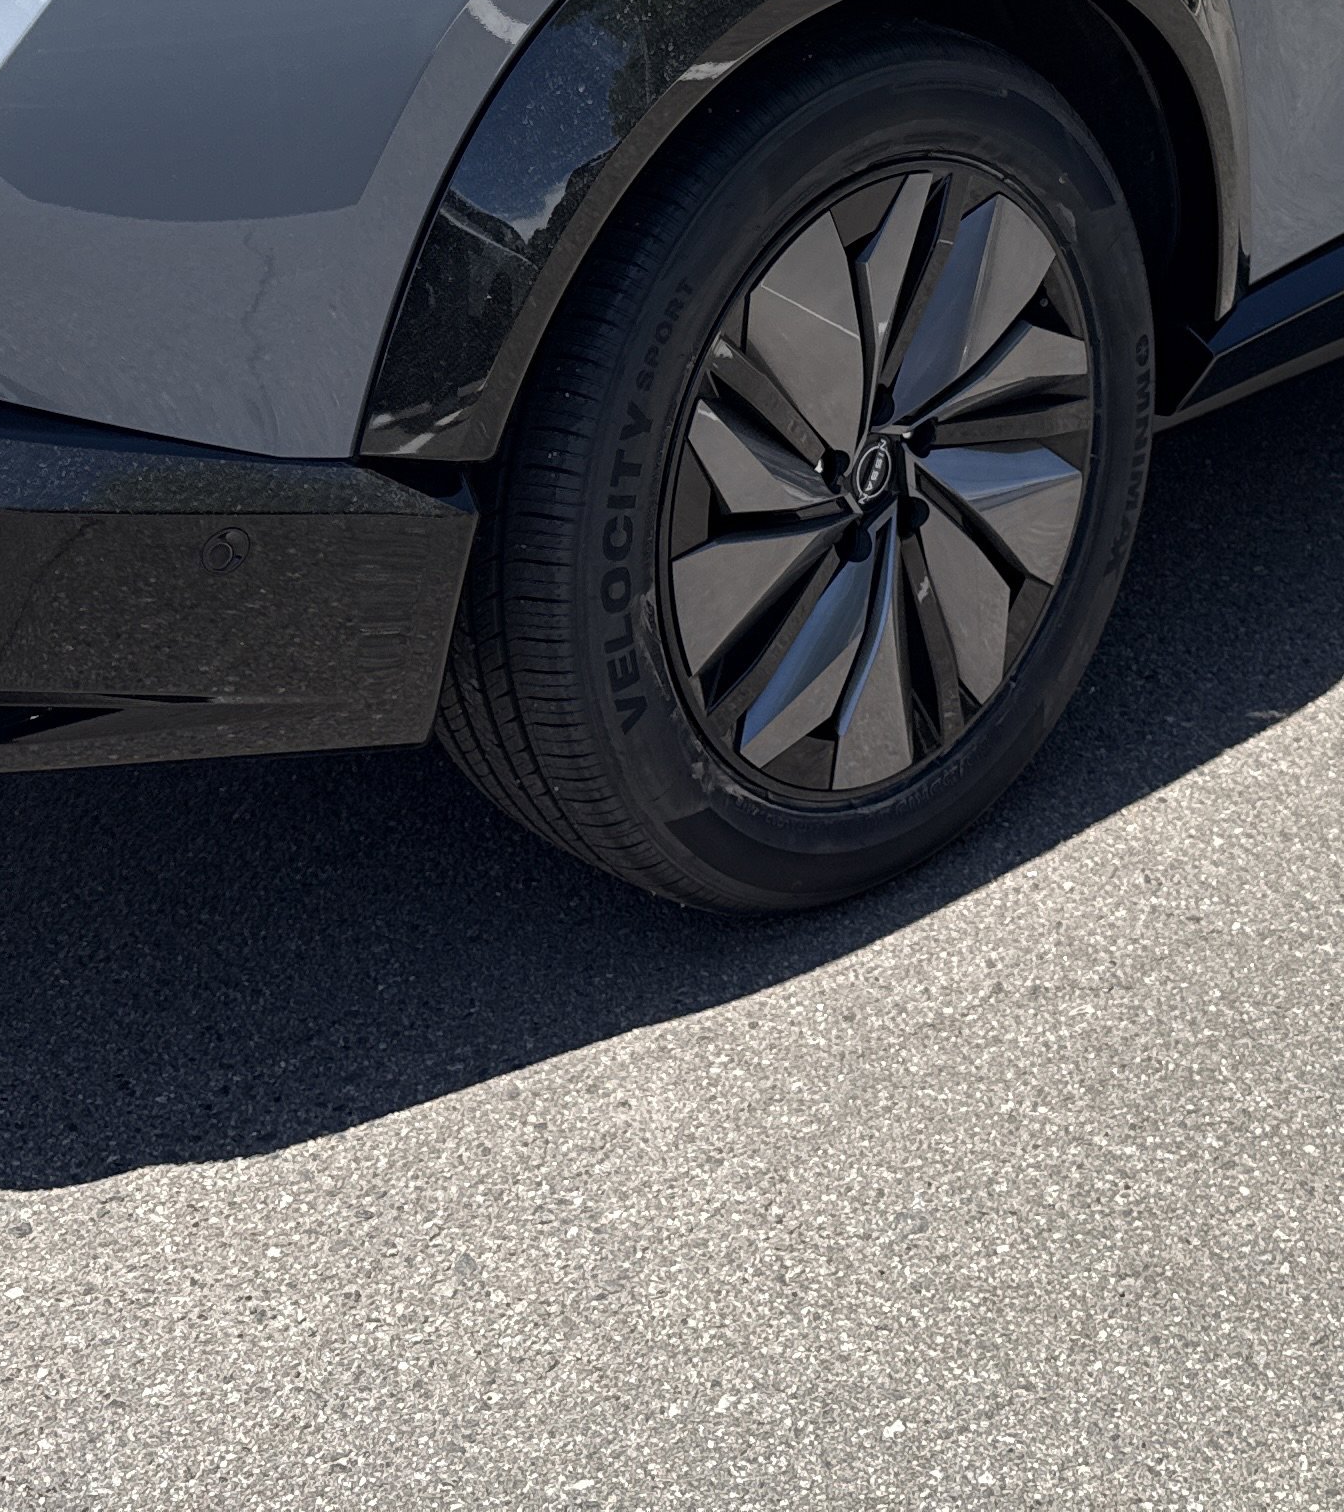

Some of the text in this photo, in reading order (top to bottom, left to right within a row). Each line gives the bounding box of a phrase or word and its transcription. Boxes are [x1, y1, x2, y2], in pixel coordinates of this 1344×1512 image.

[600, 277, 694, 735] VELOCITY SPORT
[857, 438, 888, 505] NISSAN
